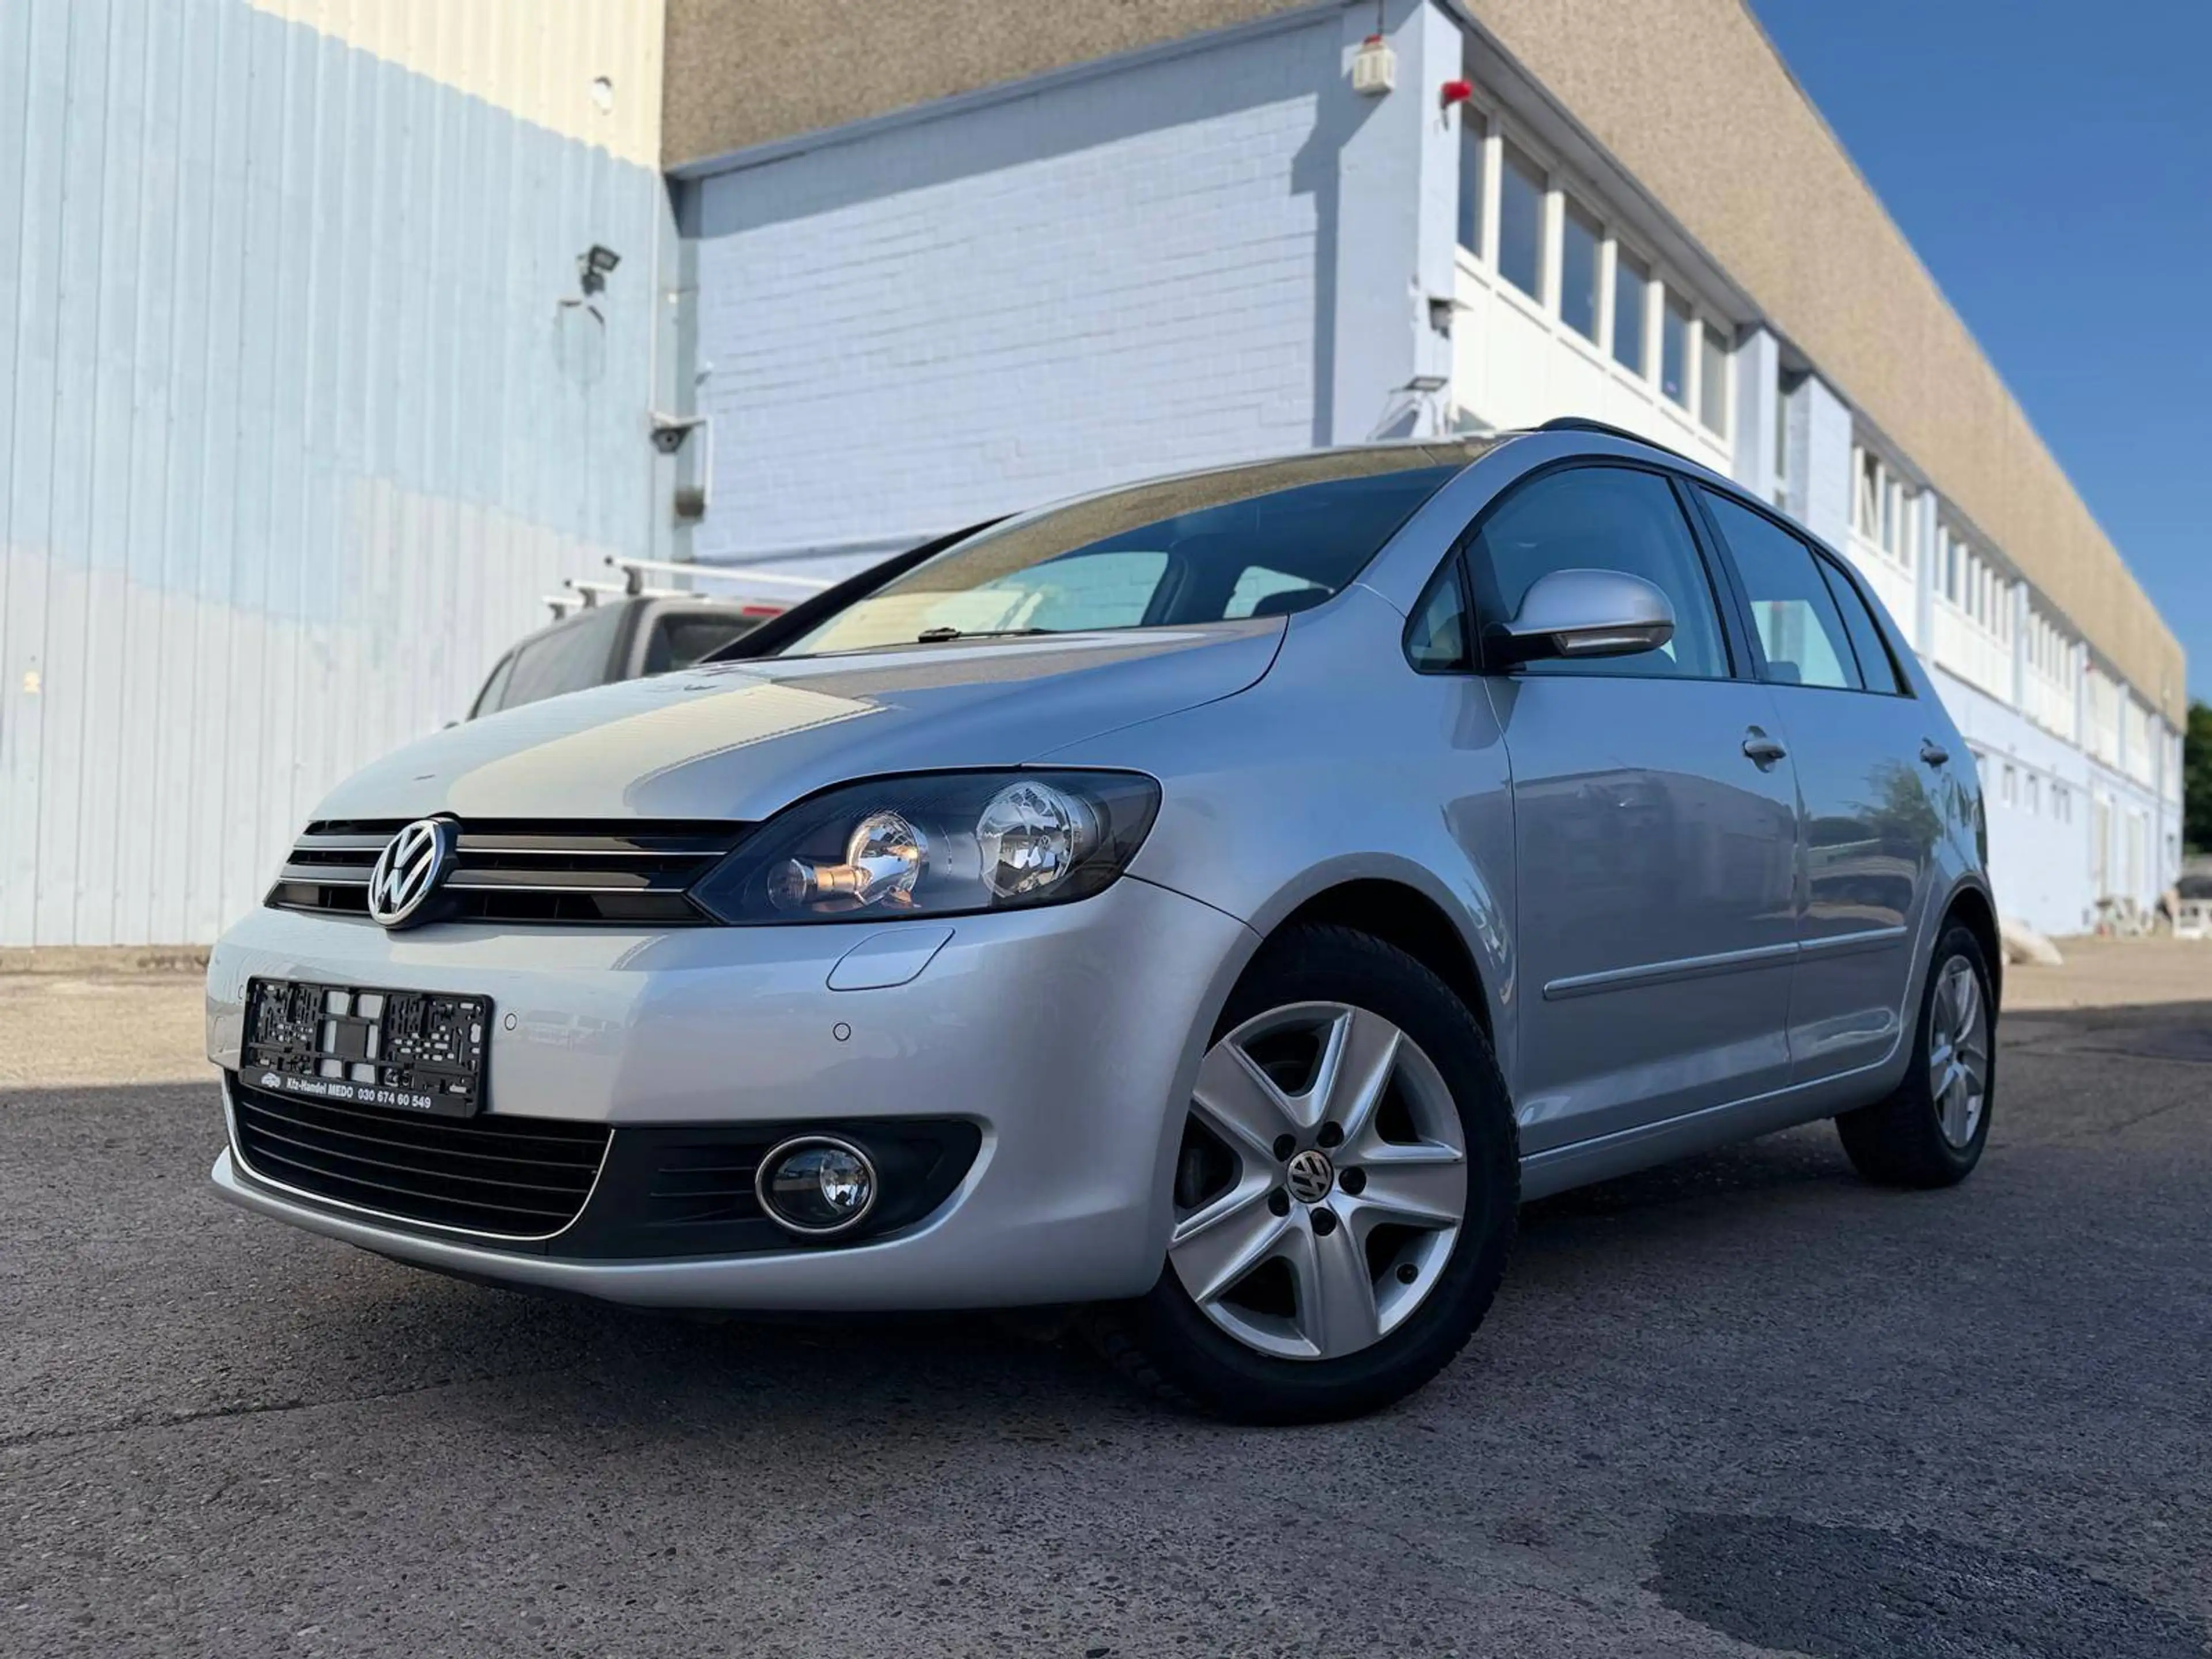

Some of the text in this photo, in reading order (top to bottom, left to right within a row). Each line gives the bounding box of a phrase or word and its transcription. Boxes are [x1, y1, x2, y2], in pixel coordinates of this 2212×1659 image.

[368, 819, 445, 925] VW
[286, 1077, 431, 1109] Kfz-Handel MEDO 030 674 60 549
[1287, 1150, 1333, 1202] VW
